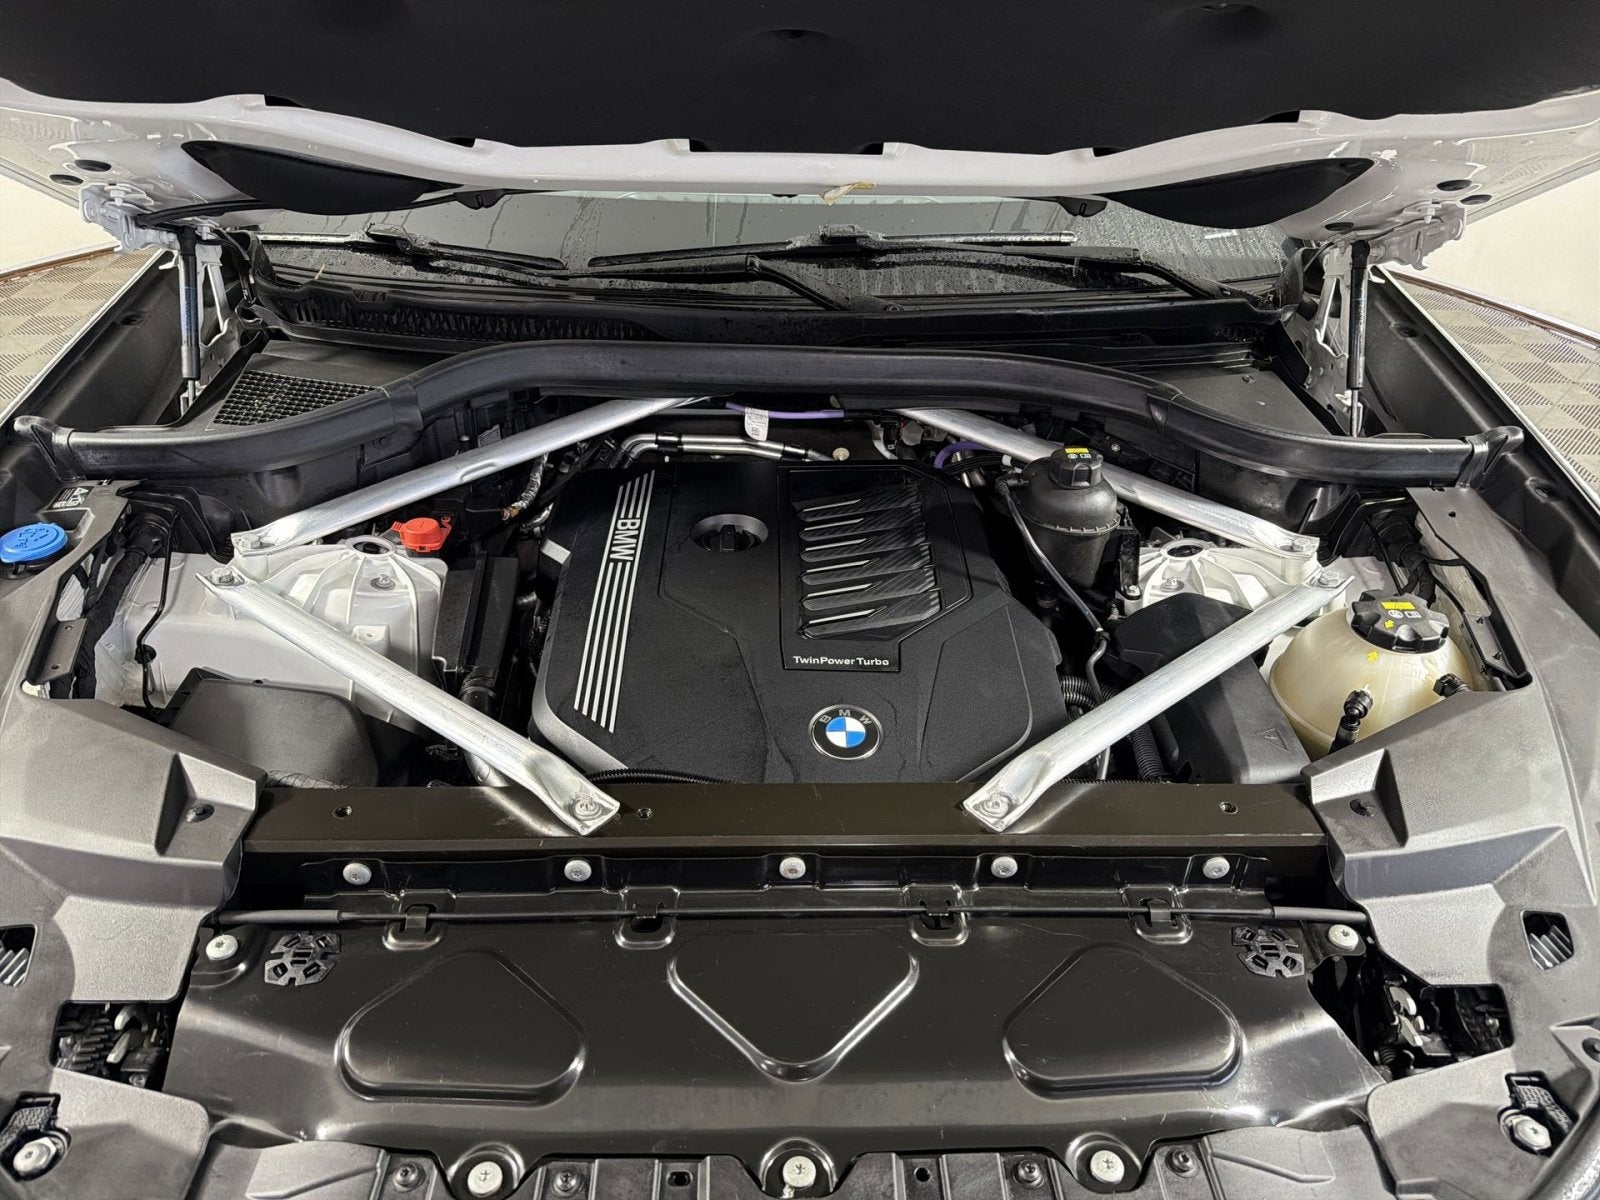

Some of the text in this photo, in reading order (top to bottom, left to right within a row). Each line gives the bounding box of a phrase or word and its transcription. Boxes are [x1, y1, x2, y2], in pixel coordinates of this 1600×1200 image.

[610, 519, 641, 560] BMW
[793, 655, 889, 666] TwinPower Turbo
[819, 709, 873, 725] BMW
